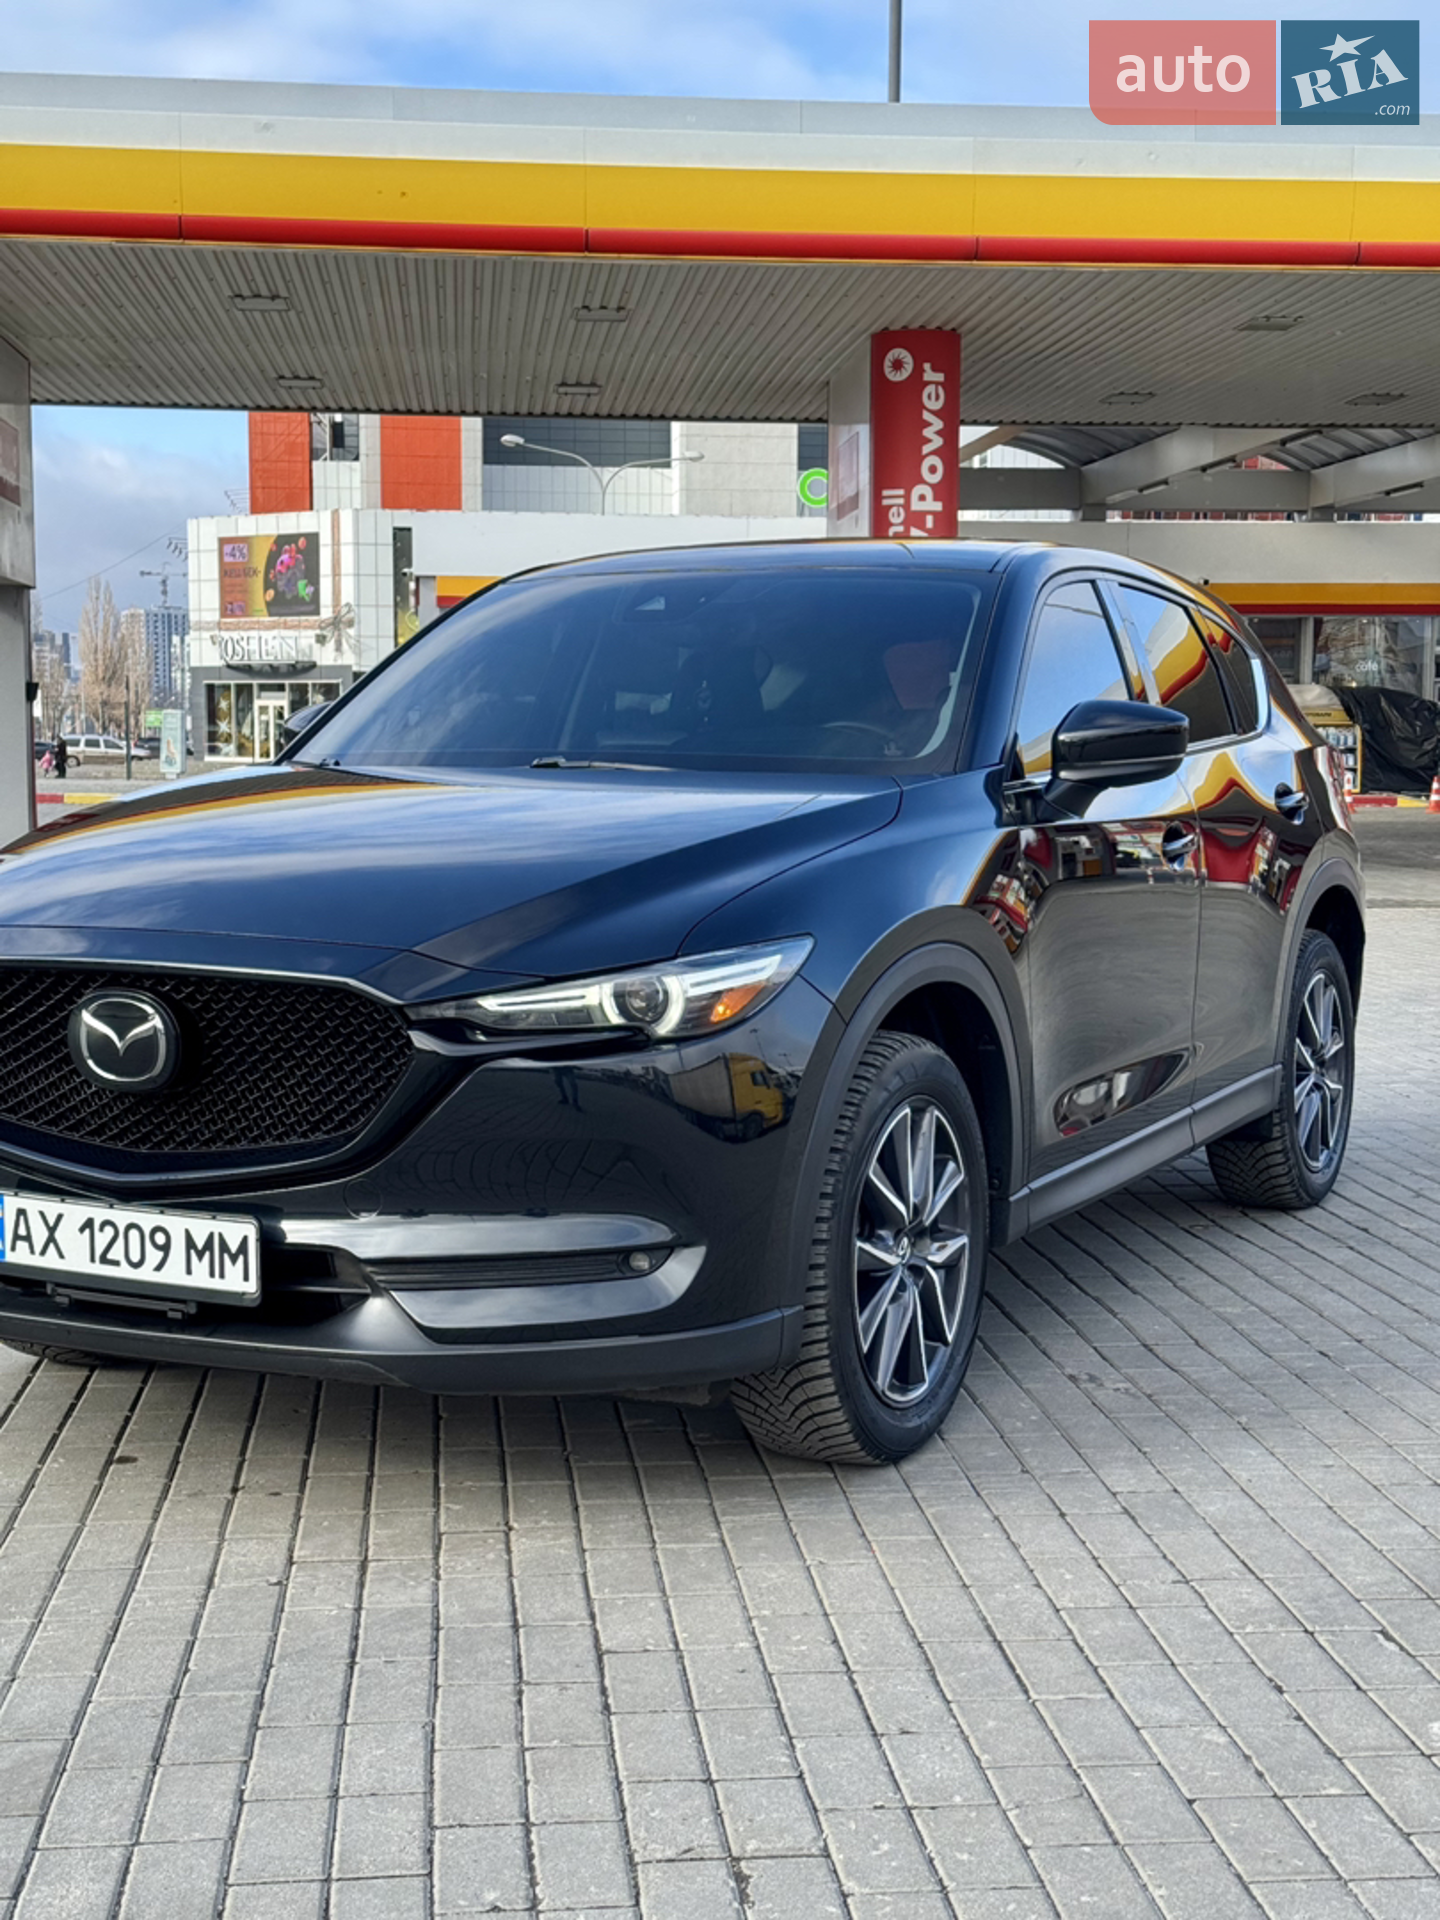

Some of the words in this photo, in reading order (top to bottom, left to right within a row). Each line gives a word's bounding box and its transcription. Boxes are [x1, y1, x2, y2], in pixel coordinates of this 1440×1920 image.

[10, 1207, 66, 1260] AX
[78, 1216, 172, 1272] 1209
[185, 1227, 250, 1282] MM
